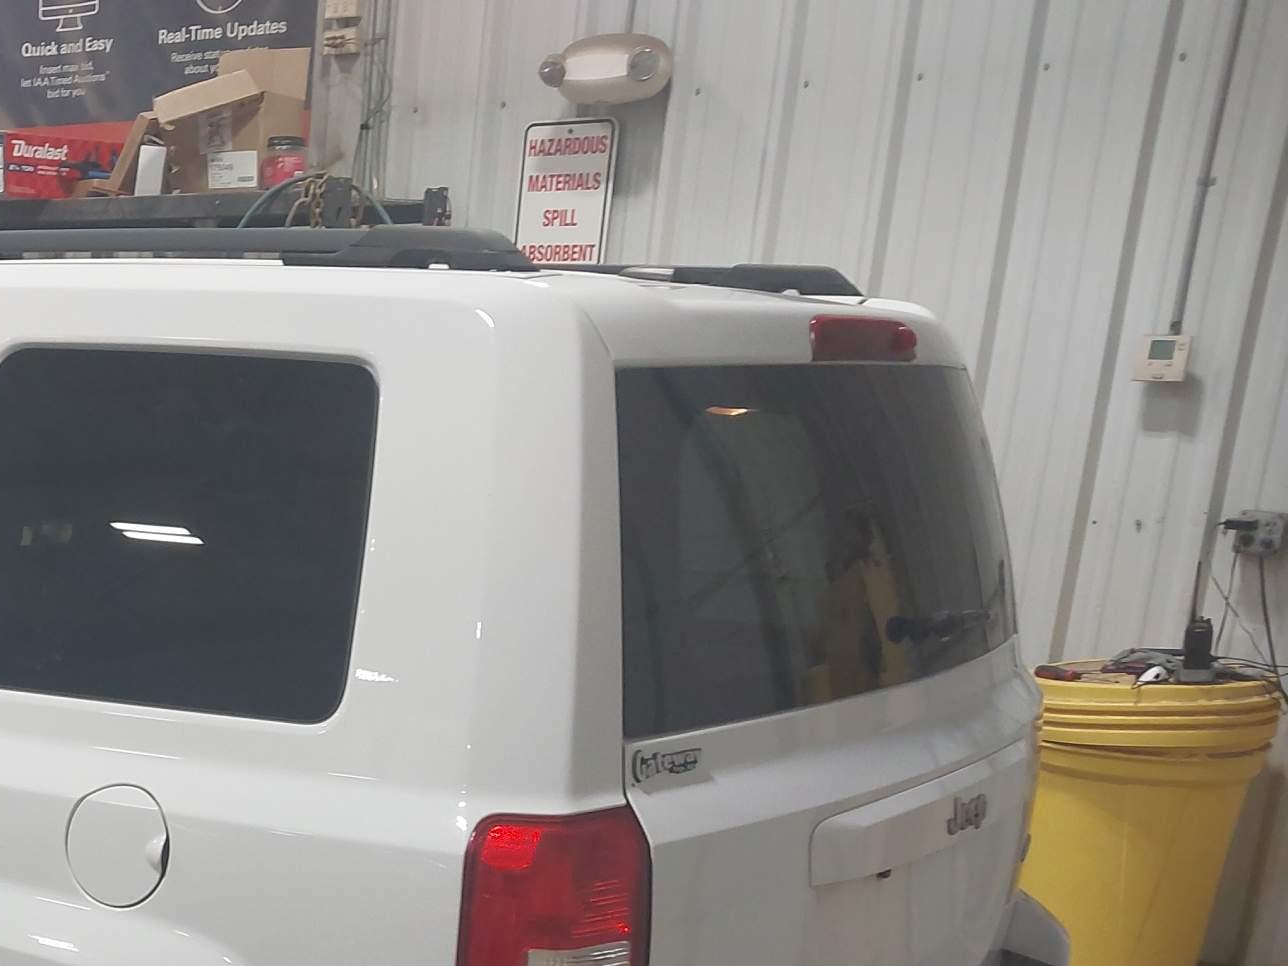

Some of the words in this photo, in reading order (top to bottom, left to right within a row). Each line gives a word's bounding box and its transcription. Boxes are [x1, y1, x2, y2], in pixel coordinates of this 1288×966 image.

[158, 25, 223, 45] Real-Time
[226, 20, 288, 40] Updates
[21, 41, 58, 57] Quick
[60, 38, 83, 54] and
[84, 37, 114, 53] Easy
[11, 140, 68, 160] Duralast
[528, 135, 609, 157] HAZARDOUS
[527, 172, 602, 193] MATERIALS
[542, 208, 578, 227] SPILL
[947, 793, 987, 836] Jeep
